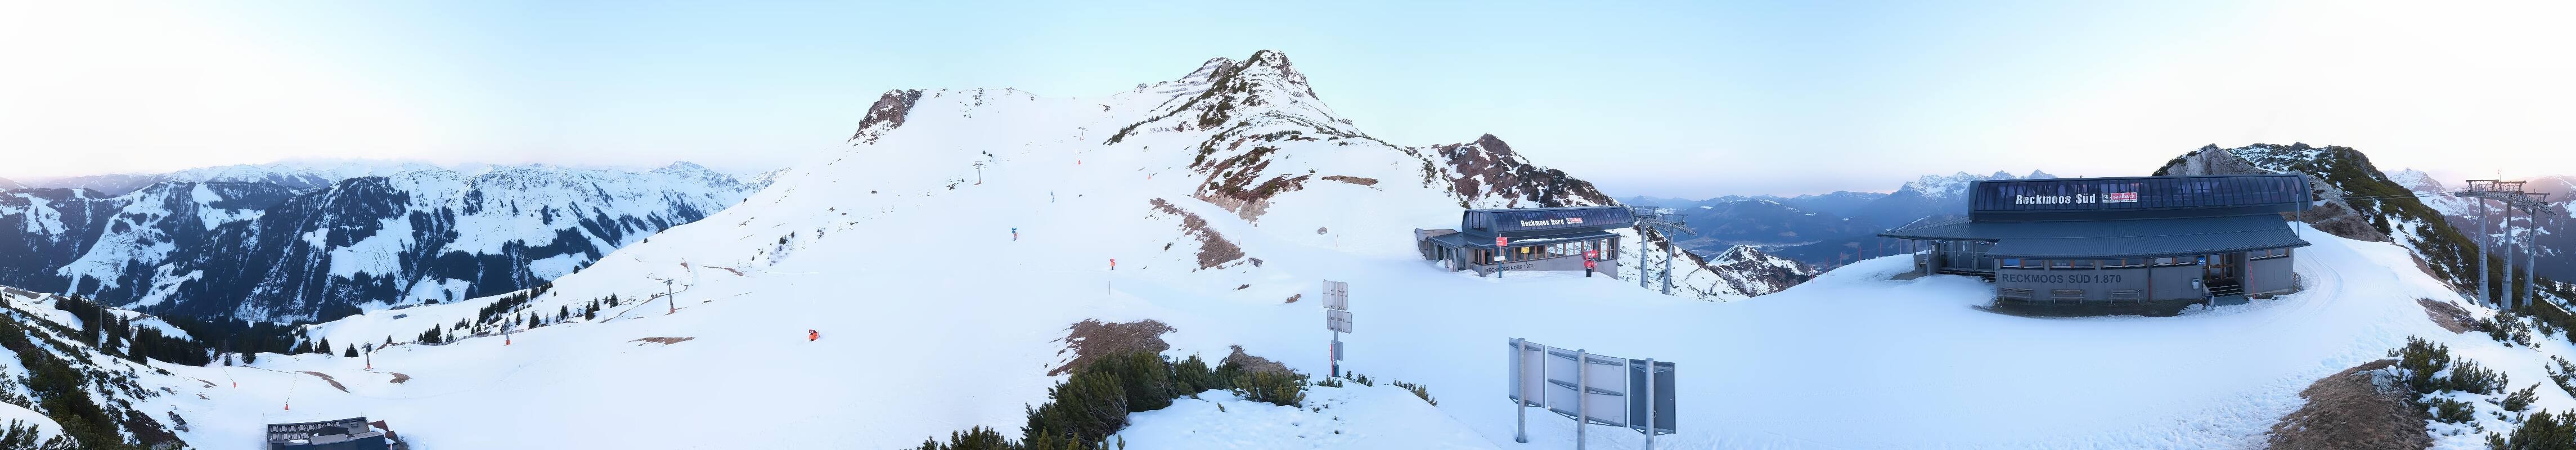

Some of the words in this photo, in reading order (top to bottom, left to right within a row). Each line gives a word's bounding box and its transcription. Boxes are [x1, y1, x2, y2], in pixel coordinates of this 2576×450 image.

[2016, 195, 2071, 205] Reckmoos
[2075, 193, 2096, 204] Süd
[2002, 274, 2064, 284] RECKMOOS
[2069, 273, 2091, 284] SÜD
[2094, 274, 2121, 284] 1.870
